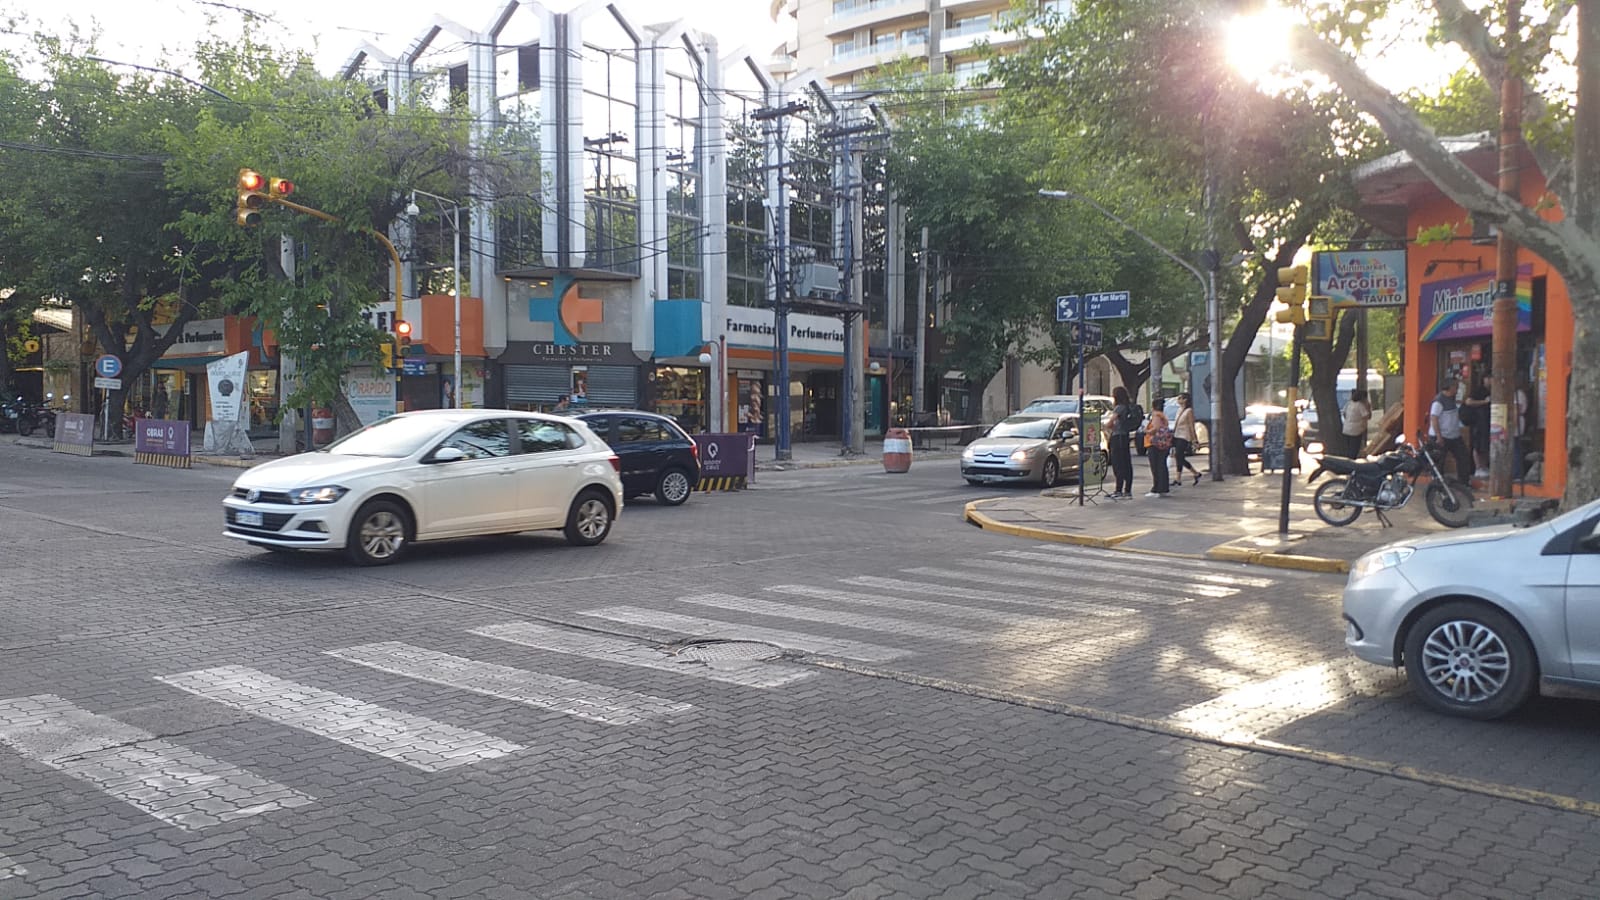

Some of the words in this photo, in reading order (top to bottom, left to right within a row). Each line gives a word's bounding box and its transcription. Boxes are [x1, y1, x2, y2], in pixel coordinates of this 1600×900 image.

[1327, 274, 1398, 290] Arcoiris
[1363, 294, 1402, 304] TAVITO
[1432, 280, 1497, 315] Minimark
[726, 318, 776, 335] Farmacias
[533, 344, 612, 356] CHESTER
[103, 360, 114, 373] E
[146, 427, 164, 438] OBRAS
